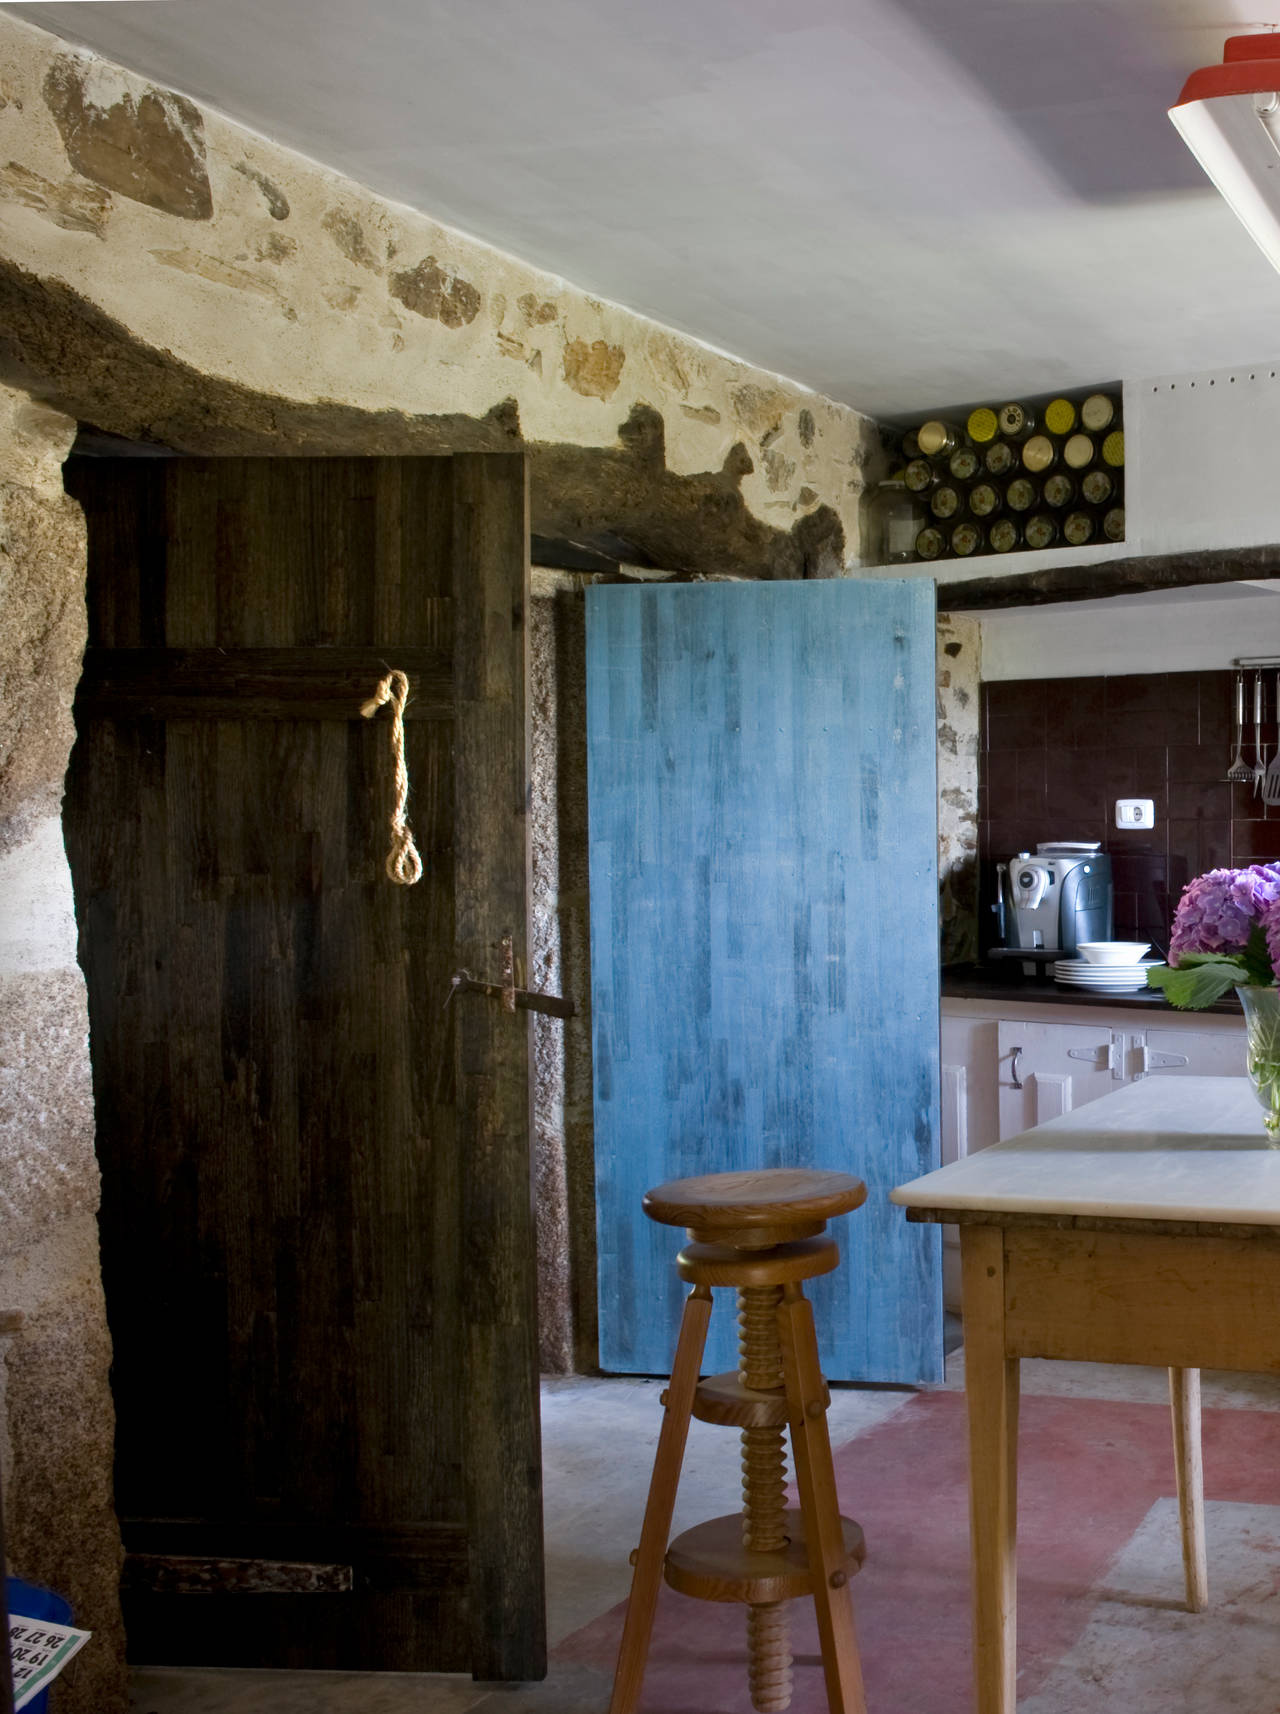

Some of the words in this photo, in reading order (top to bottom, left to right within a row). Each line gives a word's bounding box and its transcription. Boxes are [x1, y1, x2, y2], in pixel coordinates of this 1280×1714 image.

[9, 1627, 28, 1639] 28
[24, 1631, 47, 1644] 27
[44, 1635, 65, 1649] 26
[12, 1647, 32, 1661] 20
[29, 1652, 48, 1666] 19
[14, 1667, 33, 1679] 12
